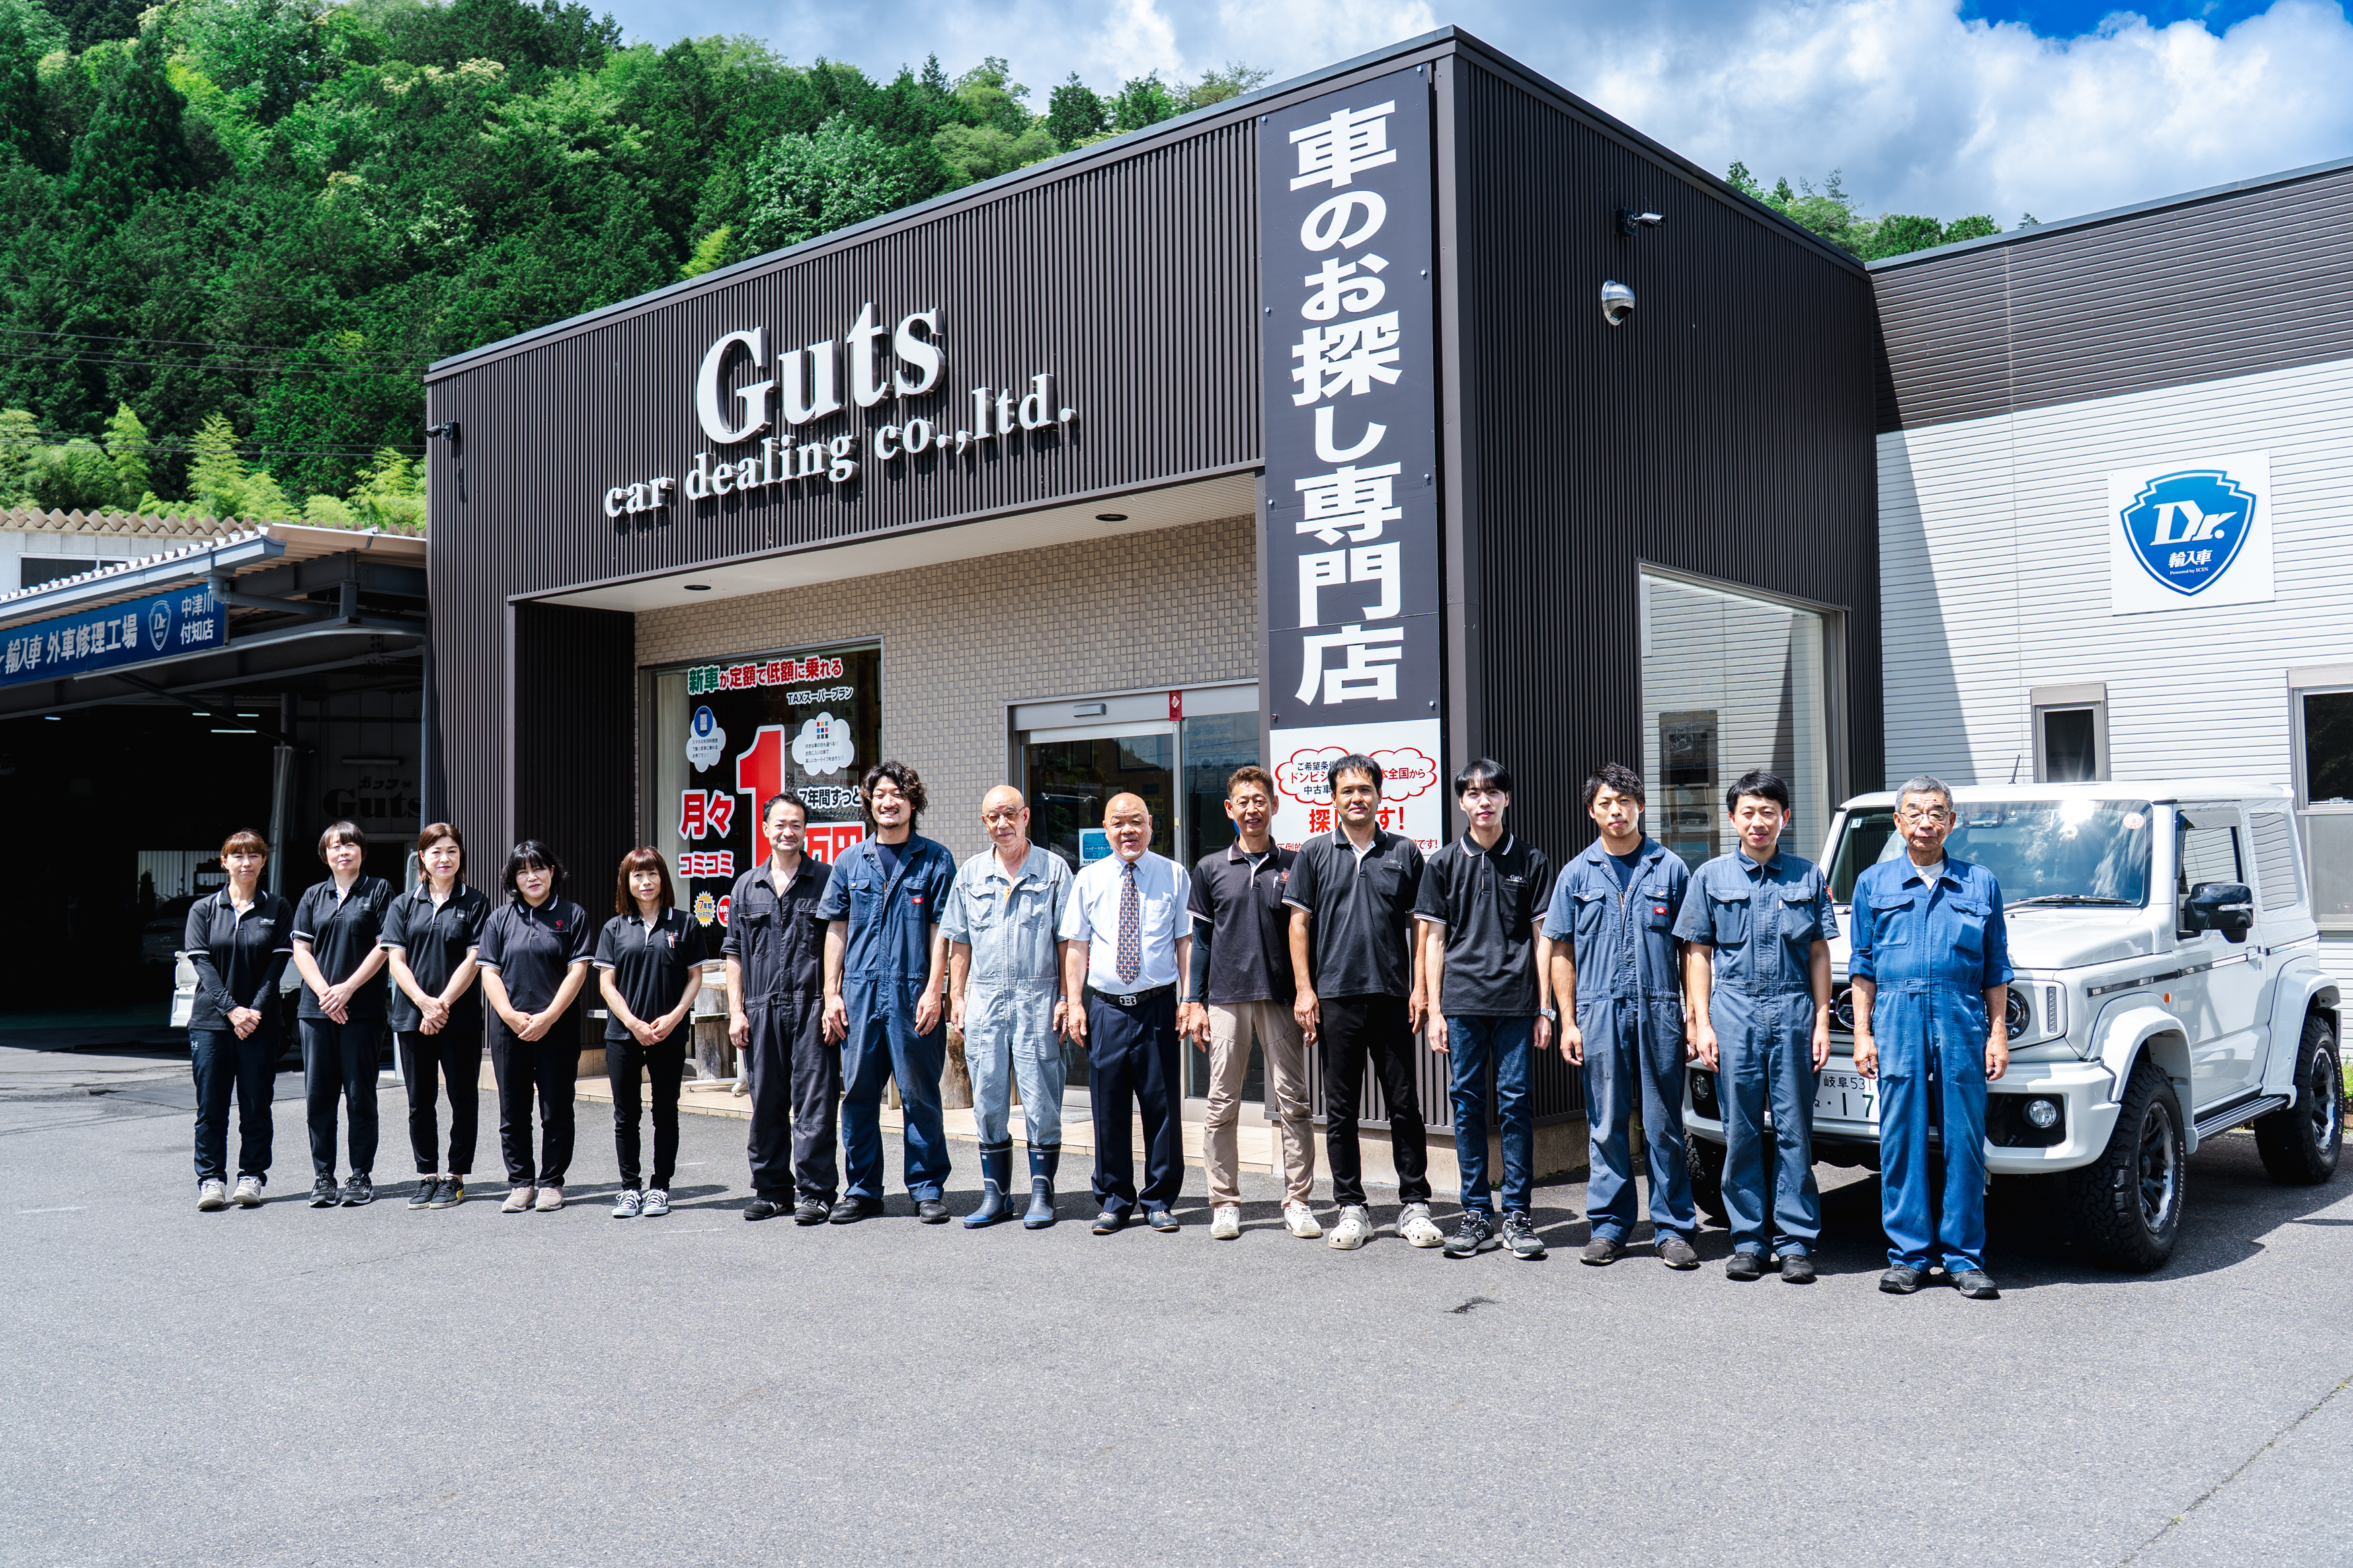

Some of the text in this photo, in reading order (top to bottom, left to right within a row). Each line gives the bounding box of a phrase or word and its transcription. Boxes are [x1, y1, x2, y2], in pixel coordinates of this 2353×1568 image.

[696, 301, 945, 445] Guts
[1289, 99, 1404, 706] 車のお探し専門店
[604, 475, 674, 518] car
[685, 434, 860, 501] dealing
[2150, 500, 2237, 546] Dr.
[2168, 549, 2212, 568] 輸入車
[181, 593, 214, 618] 中津川
[5, 613, 138, 674] 輸入車 外車修理工場
[180, 618, 214, 645] 付知店
[688, 656, 843, 694] 新車が定額で低額に乗れる
[787, 687, 853, 704] TAXスーパープラン
[323, 788, 421, 819] Guts
[680, 790, 733, 838] 月々
[680, 851, 733, 877] コミコミ
[699, 900, 713, 910] 7年間
